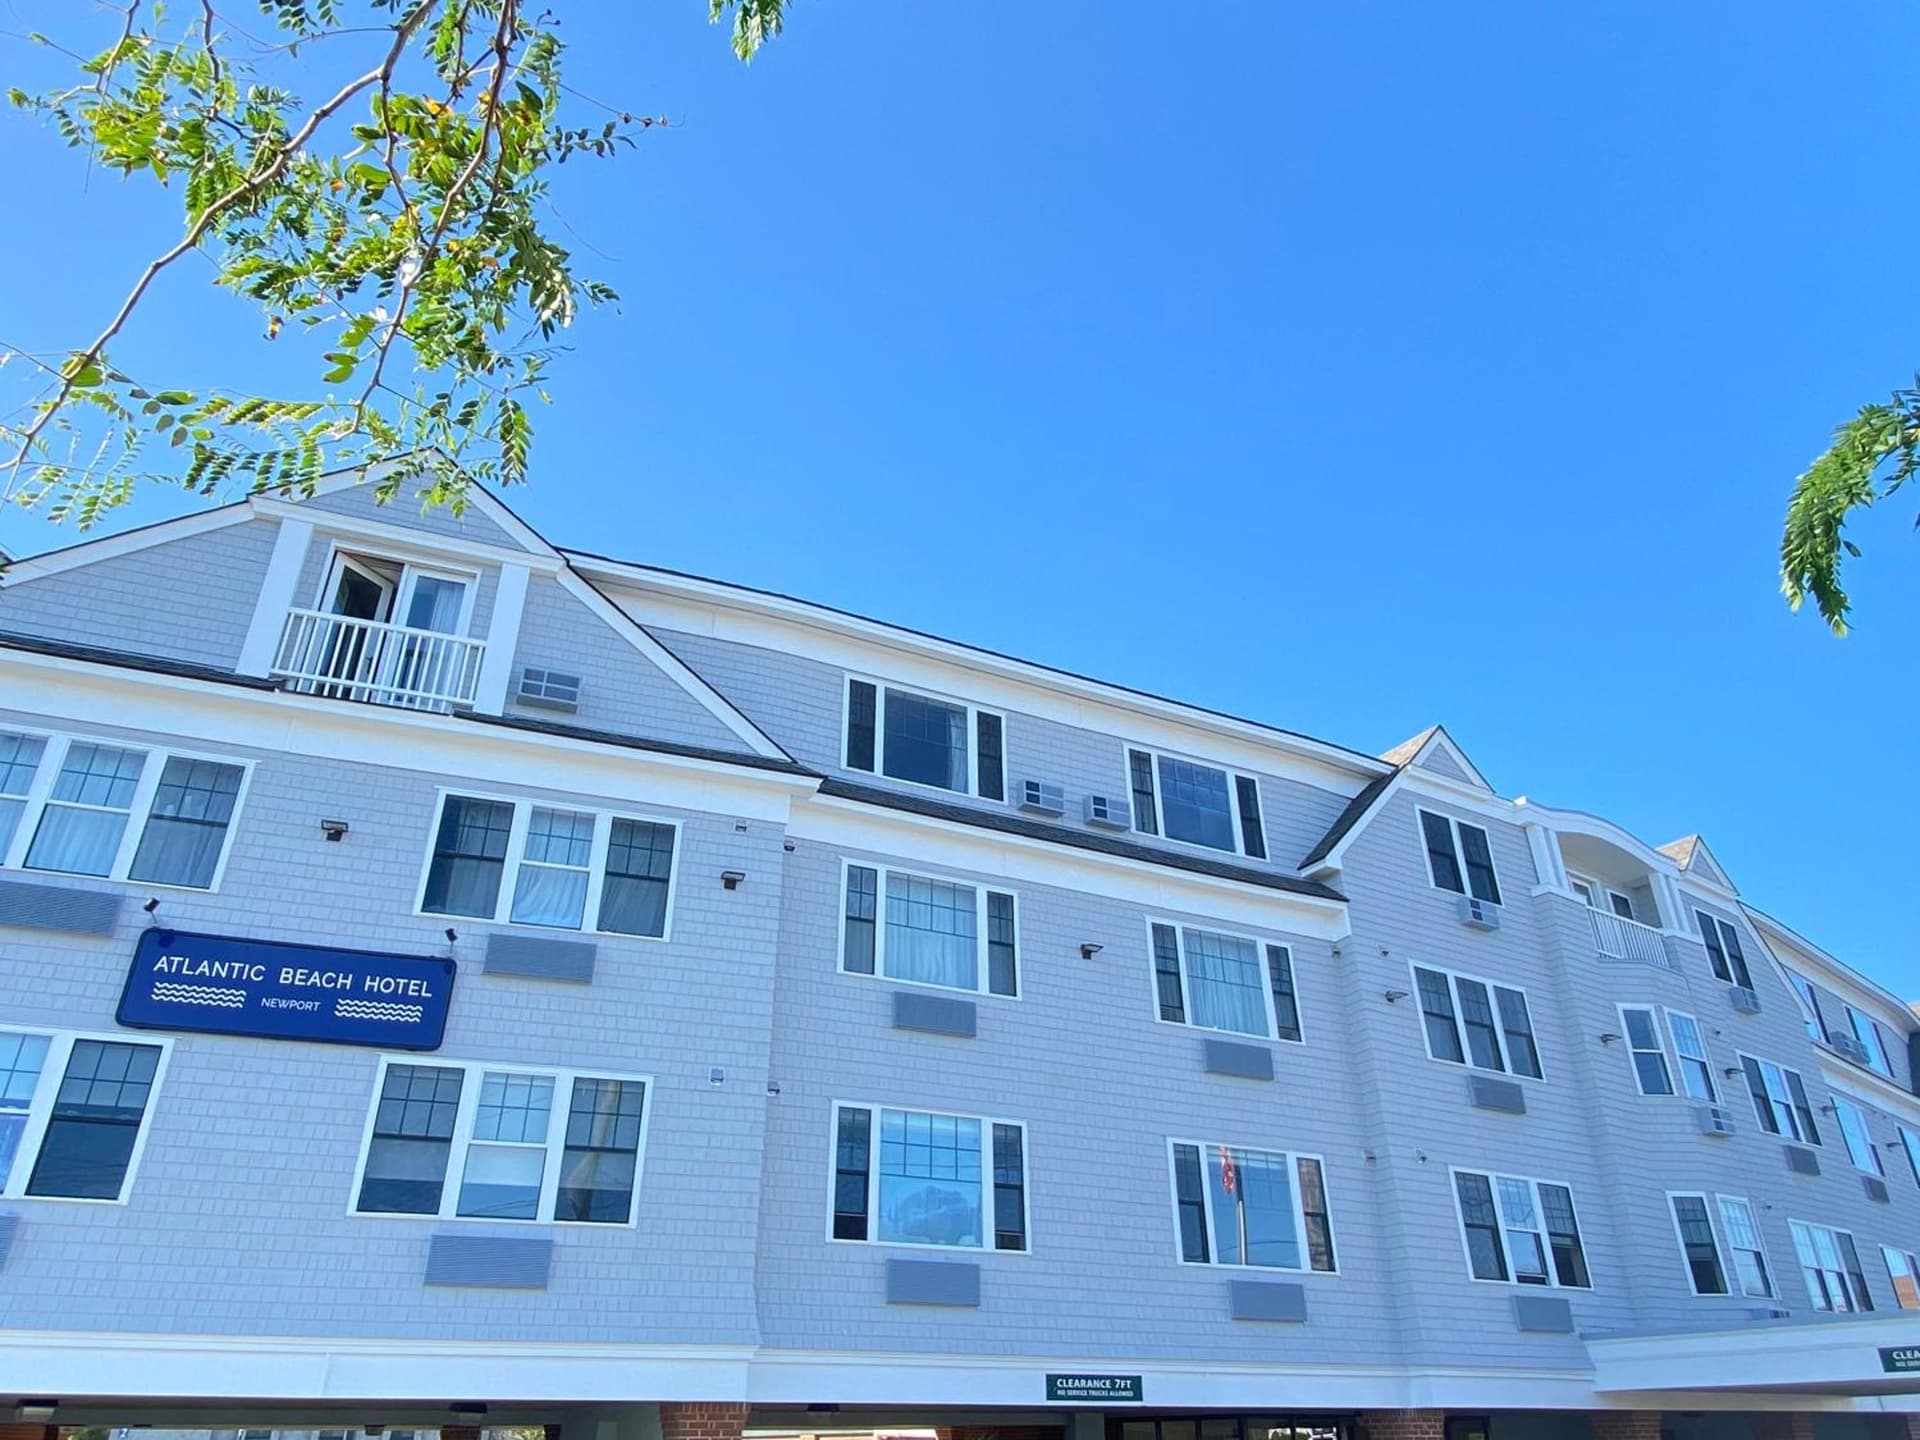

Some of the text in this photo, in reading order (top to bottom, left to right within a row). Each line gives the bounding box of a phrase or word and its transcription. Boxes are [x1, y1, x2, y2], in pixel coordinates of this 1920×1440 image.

[153, 955, 434, 998] ATLANTIC BEACH HOTEL
[260, 997, 321, 1012] NEWPORT
[1056, 1378, 1132, 1389] CLEARANCE 7FT
